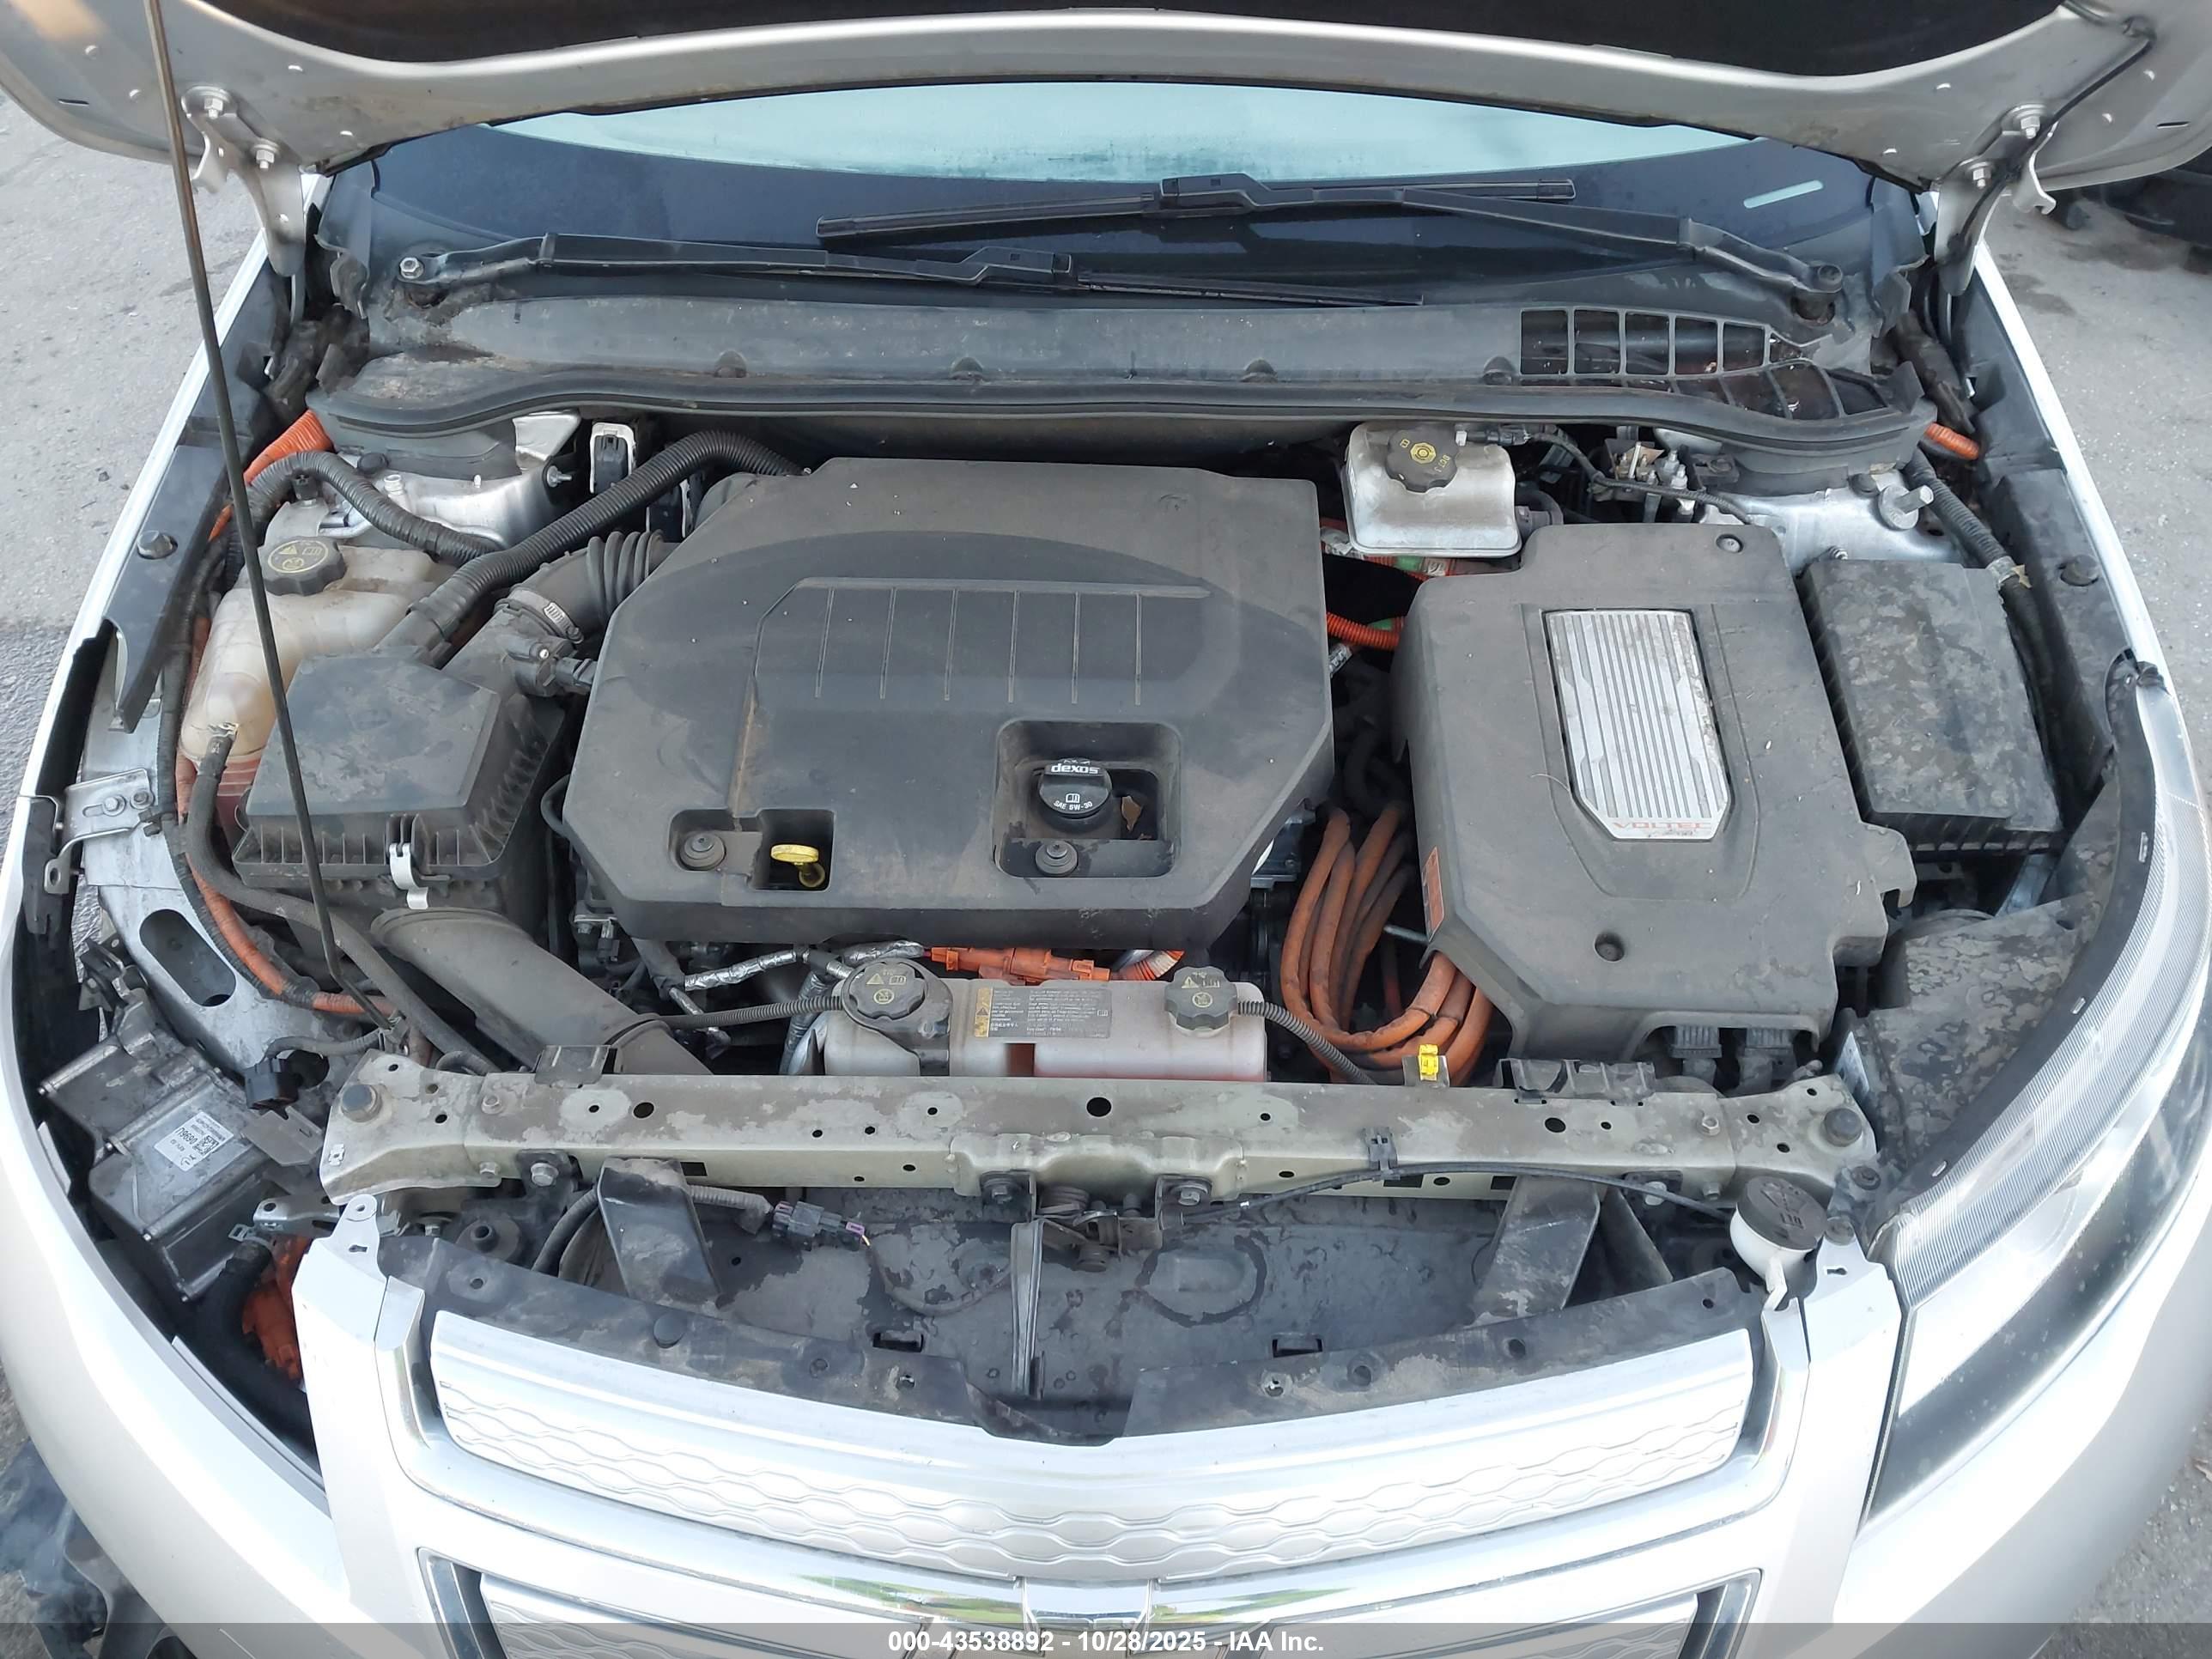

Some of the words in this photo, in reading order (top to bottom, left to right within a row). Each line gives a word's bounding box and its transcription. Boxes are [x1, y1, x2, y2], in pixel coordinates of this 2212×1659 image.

[1051, 763, 1100, 775] dexos
[1053, 800, 1067, 810] SAE
[1068, 801, 1093, 811] 5W-30
